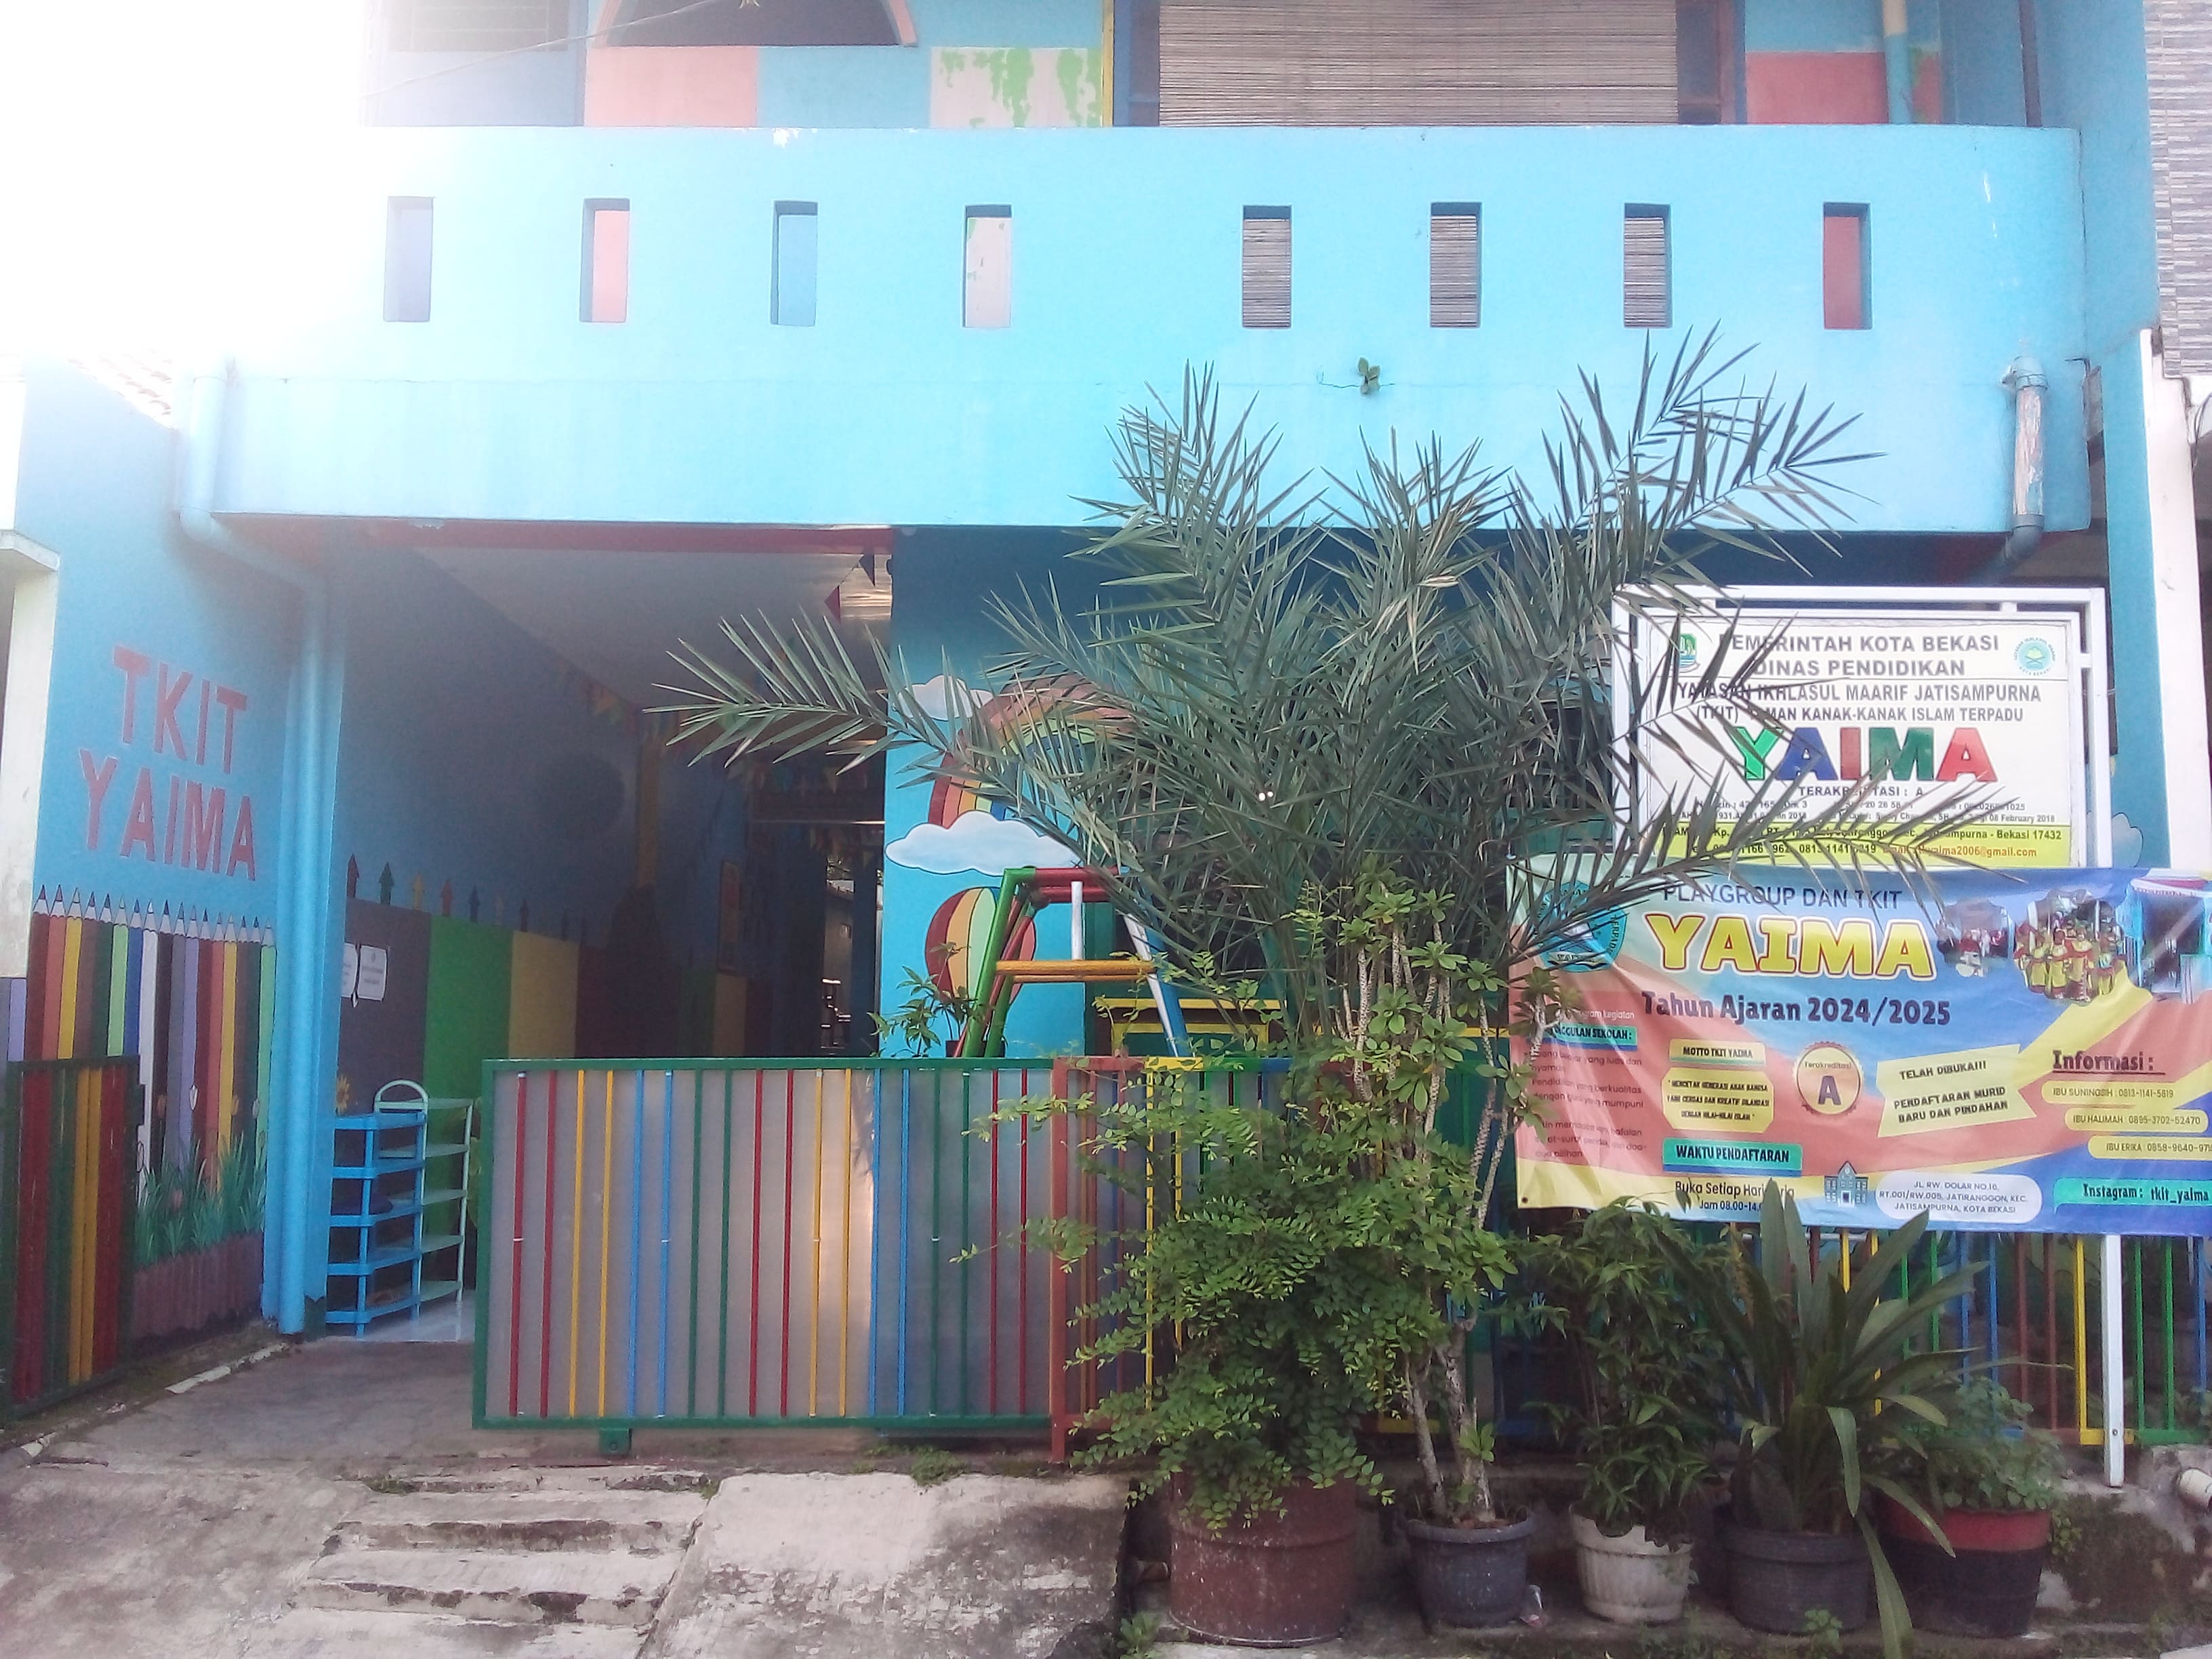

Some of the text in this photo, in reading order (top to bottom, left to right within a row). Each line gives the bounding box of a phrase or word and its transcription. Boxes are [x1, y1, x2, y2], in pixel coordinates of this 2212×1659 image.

[1860, 636, 1915, 652] KOTA
[1923, 635, 1999, 652] BEKASI
[1828, 659, 1965, 676] PENDIDIKAN
[1846, 684, 1908, 701] MAARIF
[1914, 684, 2042, 702] JATISAMPURNA
[112, 644, 247, 775] TKIT
[1802, 708, 1908, 722] KANAK-KANAK
[1912, 708, 1955, 722] ISLAM
[1960, 708, 2024, 722] TERPADU
[1729, 726, 1999, 782] YAIMA
[79, 748, 256, 882] YAIMA
[2001, 814, 2034, 824] February
[1996, 830, 2030, 840] Bekasi
[2032, 830, 2062, 840] 17432
[1662, 884, 1903, 909] PLAYGROUP DAN TKIT
[1644, 913, 1936, 979] YAIMA
[1603, 1010, 1635, 1021] kegiatan
[1641, 990, 1951, 1026] Tahun Ajaran 2024/2025
[1592, 1027, 1628, 1040] SEKOLAH
[1683, 1046, 1754, 1058] MOTTO TKIT YAIMA
[2052, 1050, 2144, 1071] Informasi
[1899, 1067, 1934, 1080] TELAH
[1595, 1084, 1642, 1094] berkualitas
[1818, 1075, 1842, 1105] A
[2053, 1088, 2068, 1096] IBU
[2069, 1088, 2113, 1097] SUNINGSIH
[2118, 1088, 2174, 1099] 0813-1141-5819
[1602, 1100, 1643, 1109] mumpuni
[1893, 1086, 2006, 1110] PENDAFTARAN MURID
[1898, 1101, 2009, 1124] BARU DAN PINDAHAN
[2073, 1115, 2086, 1123] IBU
[2087, 1115, 2123, 1124] HALIMAH
[1676, 1144, 1790, 1163] WAKTU PENDAFTARAN
[2106, 1143, 2120, 1151] IBU
[2121, 1143, 2142, 1151] ERIKA
[1675, 1181, 1703, 1194] Buka
[1706, 1181, 1742, 1199] Setiap
[1743, 1182, 1765, 1196] Hari
[1944, 1182, 1972, 1190] DOLAR
[2083, 1183, 2137, 1202] Instagram
[2150, 1185, 2210, 1204] tkit_yaima
[1699, 1200, 1718, 1210] Jam
[1963, 1205, 1986, 1213] KOTA
[1988, 1206, 2016, 1214] BEKASI
